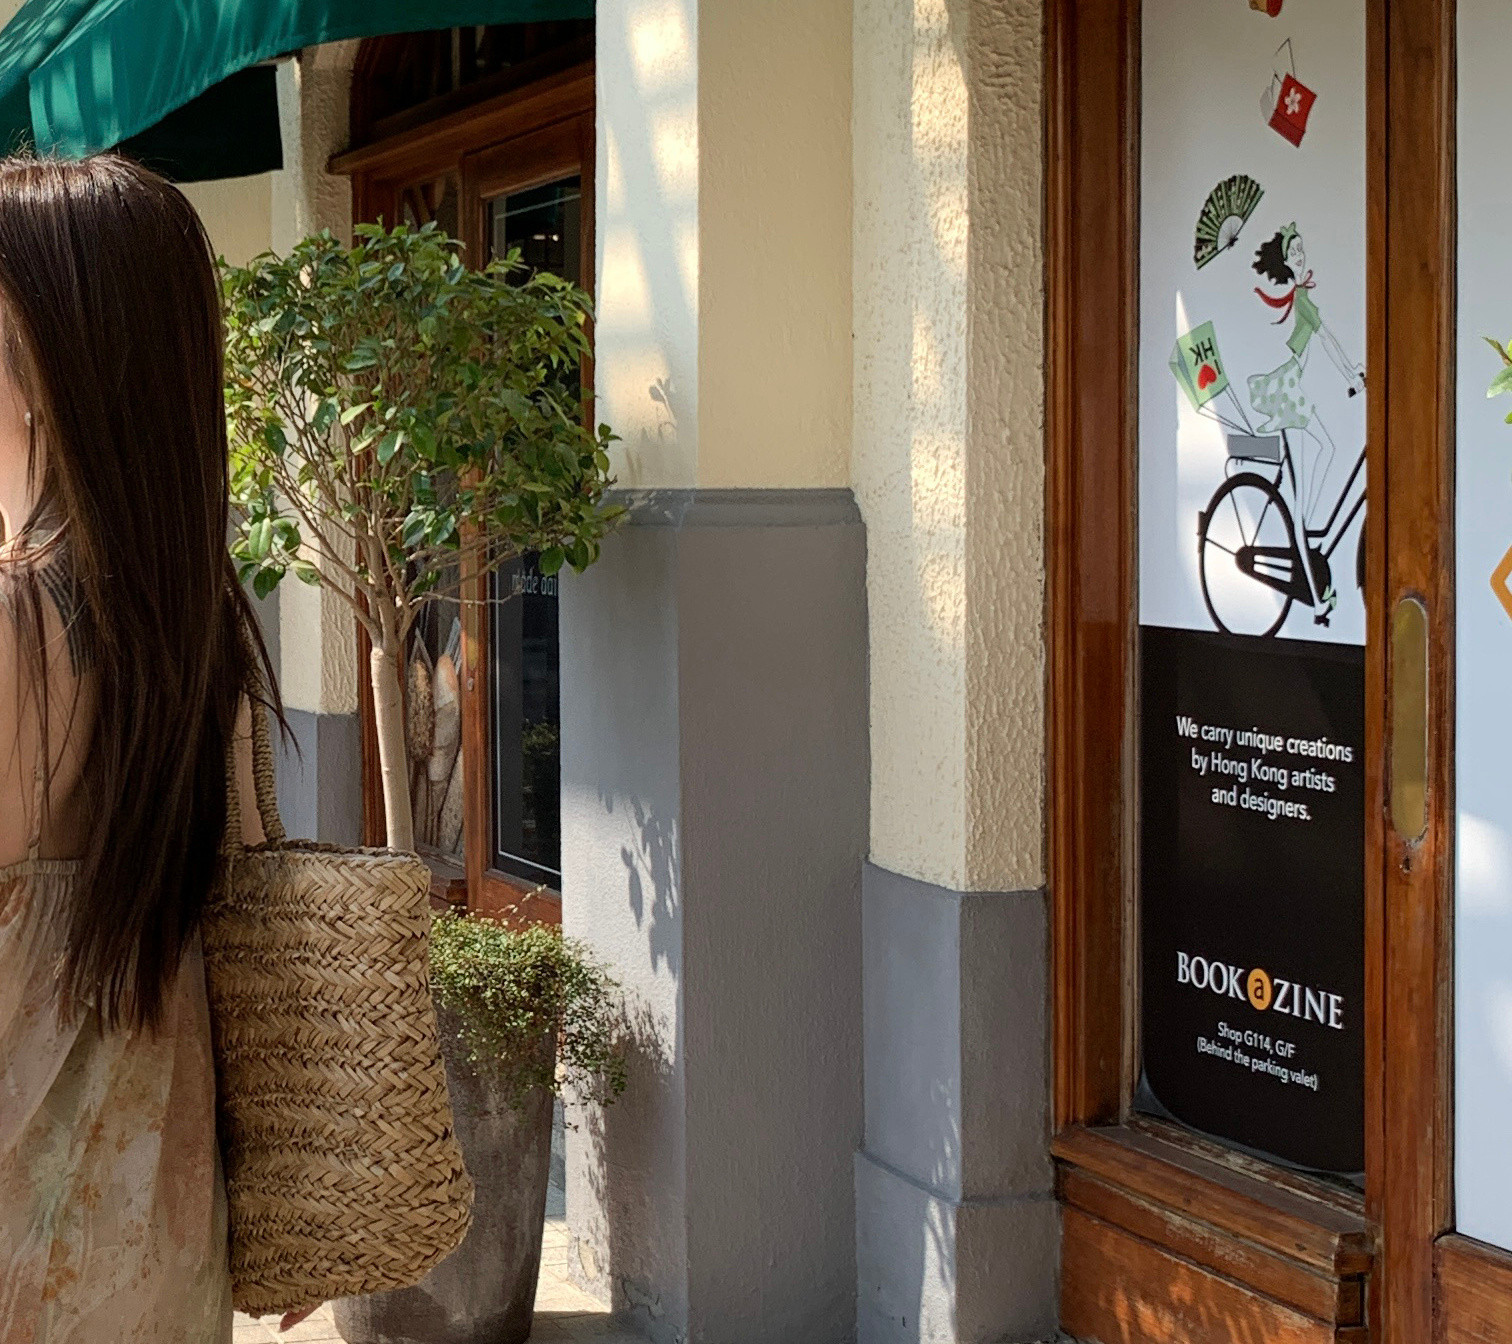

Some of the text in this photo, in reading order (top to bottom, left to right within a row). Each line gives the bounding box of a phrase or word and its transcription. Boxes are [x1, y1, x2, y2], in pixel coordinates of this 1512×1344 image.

[1189, 337, 1215, 366] HK
[1176, 715, 1354, 763] We carry unique creations
[1191, 747, 1336, 793] by Hong Kong artists
[1211, 785, 1312, 821] and designers.
[1217, 1021, 1296, 1058] Shop G114, G/F
[1196, 1036, 1319, 1092] (Behind the parking valet)
